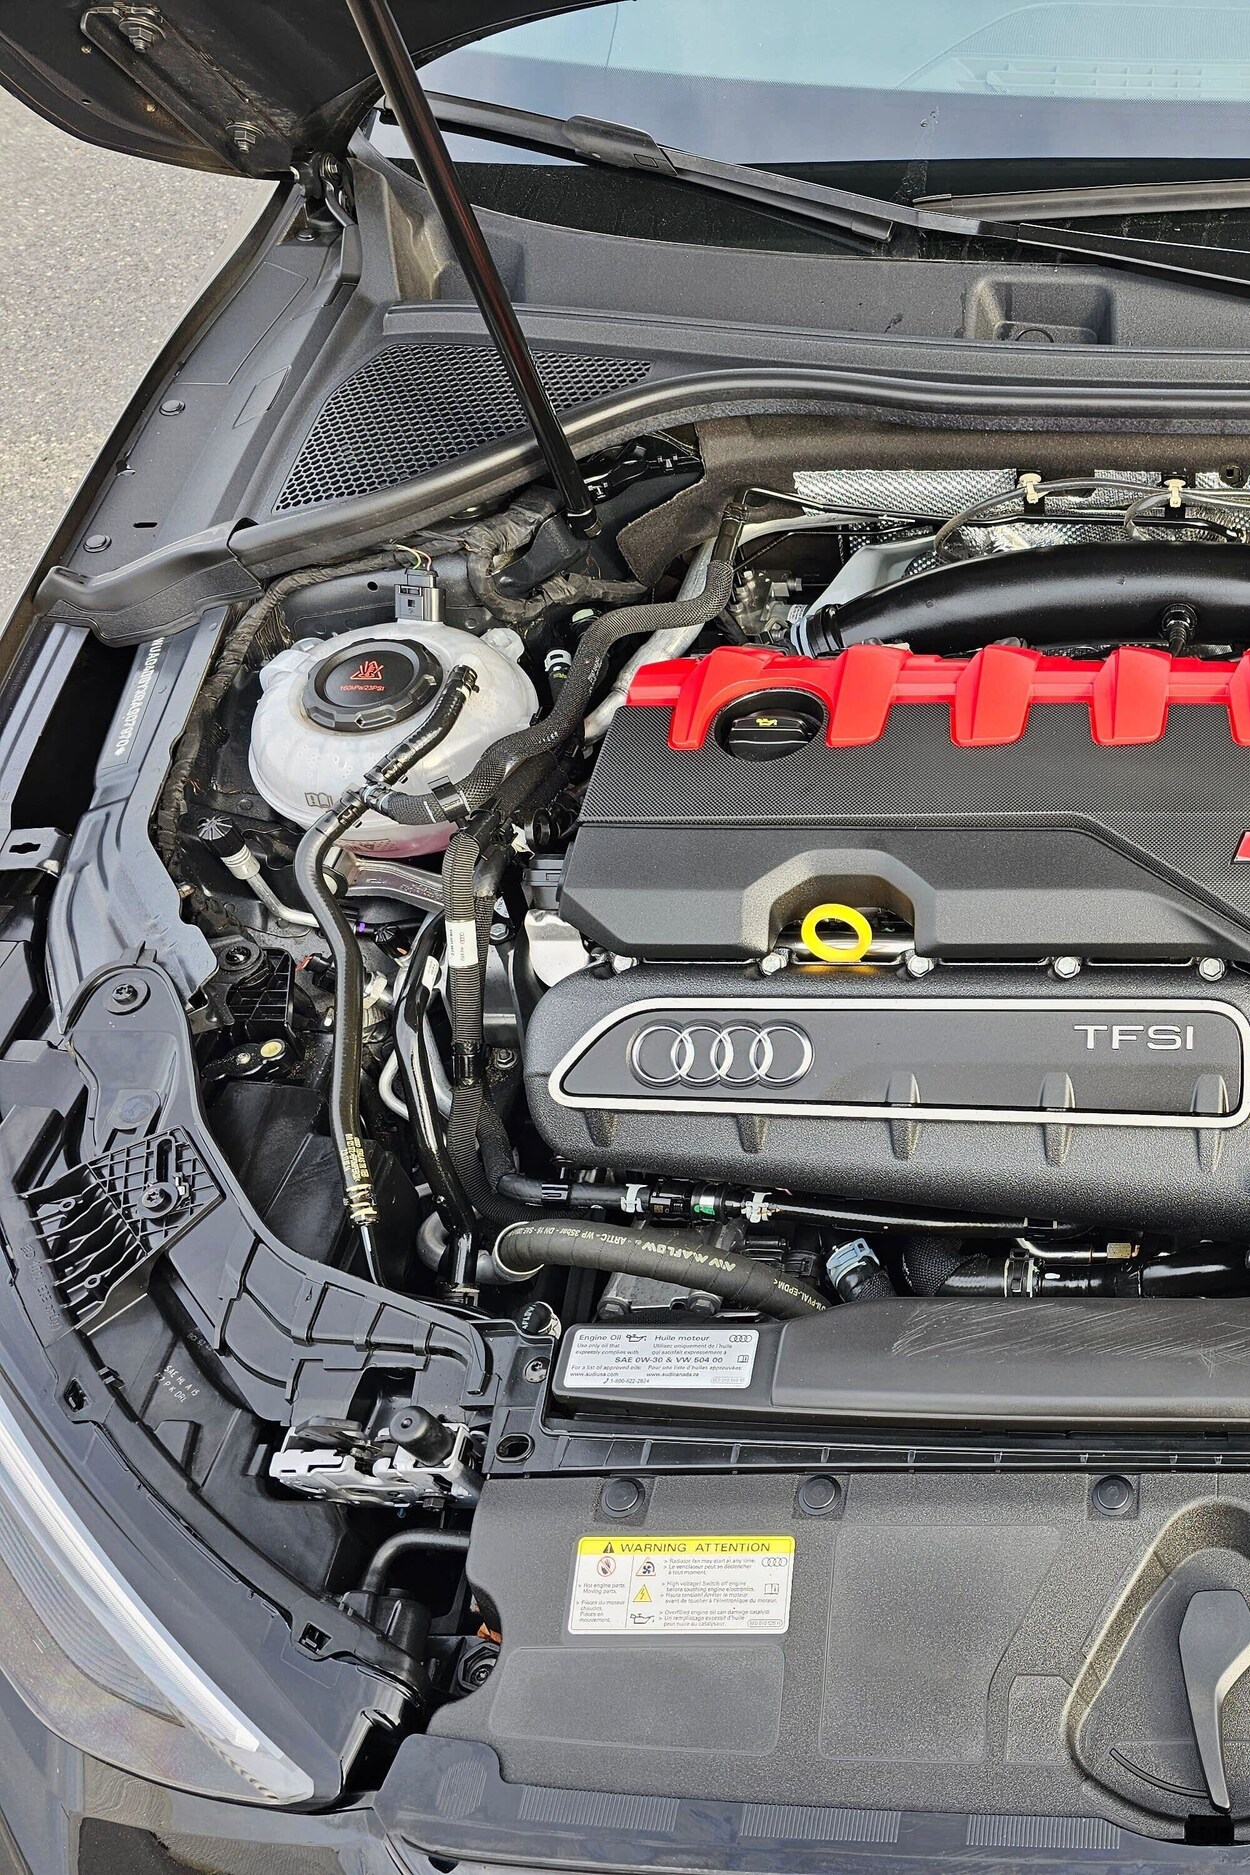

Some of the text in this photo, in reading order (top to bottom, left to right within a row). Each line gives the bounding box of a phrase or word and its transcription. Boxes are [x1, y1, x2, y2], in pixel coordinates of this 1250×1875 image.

[1074, 1025, 1194, 1050] TFSI
[642, 1242, 708, 1264] MAFLOW
[164, 1366, 178, 1378] SAE
[621, 1543, 770, 1552] WARNING ATTENTION
